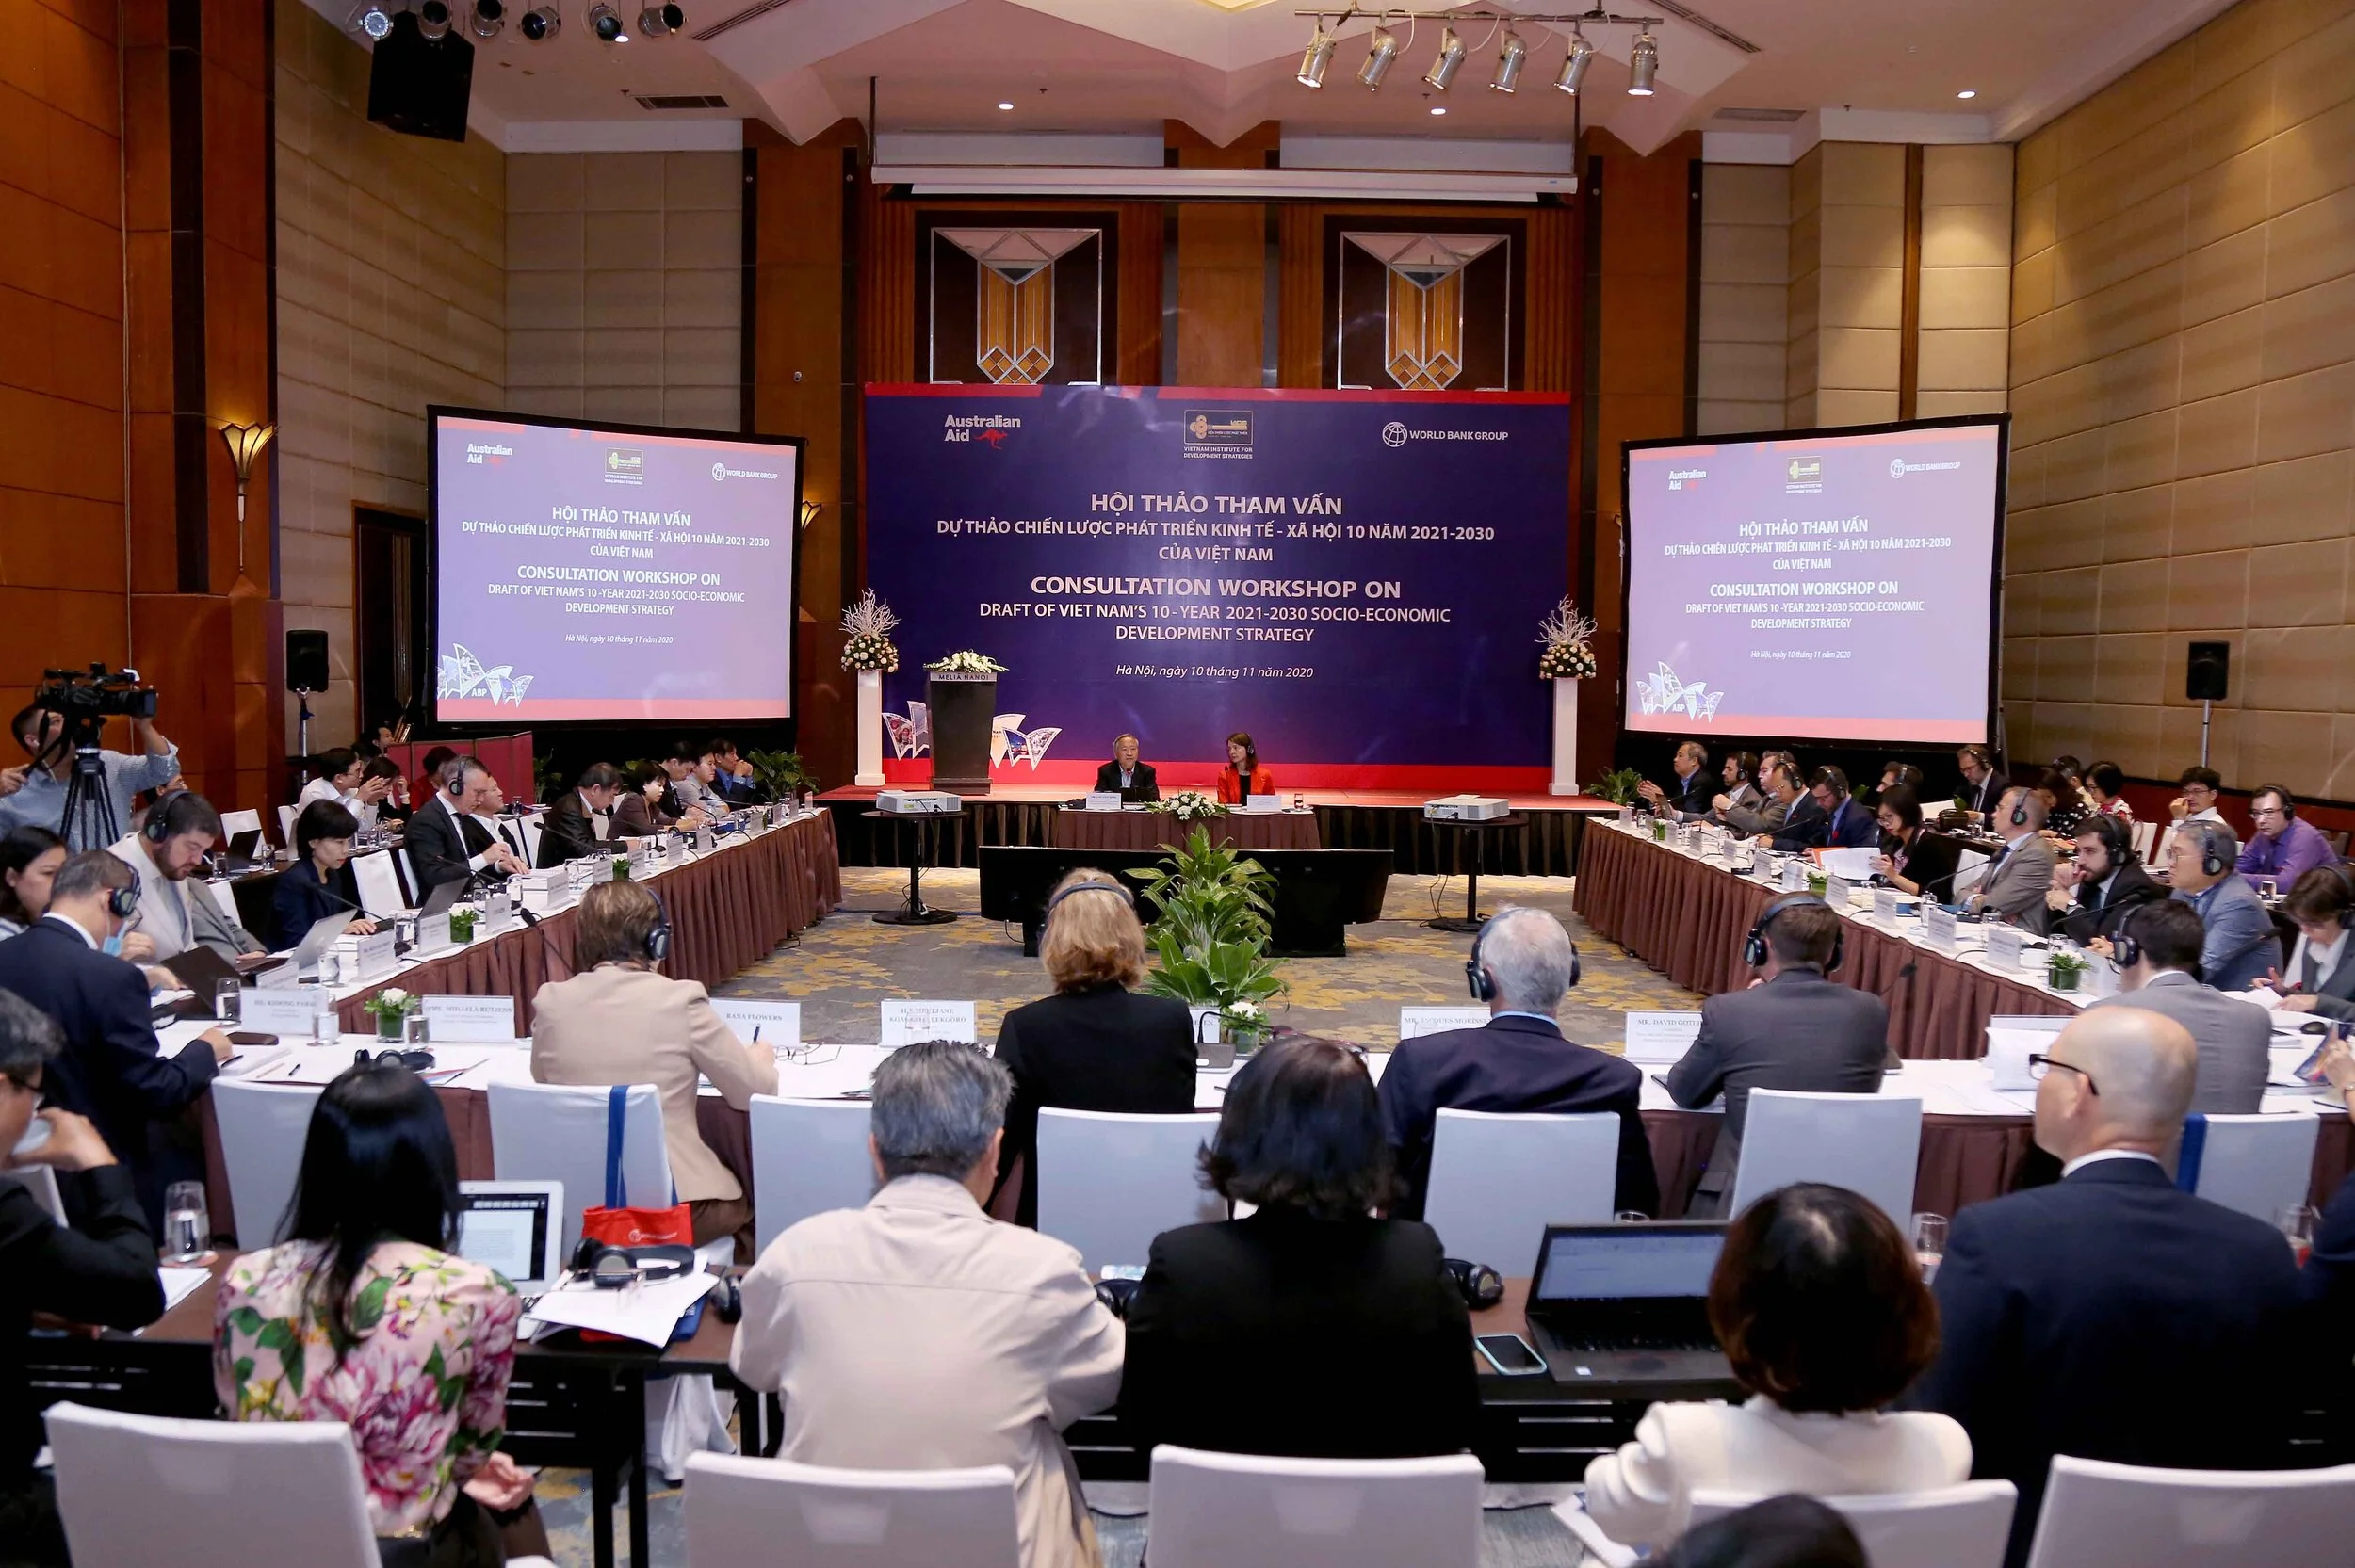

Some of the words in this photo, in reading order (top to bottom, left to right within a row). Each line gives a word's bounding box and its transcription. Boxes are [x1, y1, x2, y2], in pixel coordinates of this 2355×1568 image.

[945, 415, 1021, 428] Australian
[944, 429, 970, 442] Aid
[1410, 430, 1445, 439] WORLD
[1448, 431, 1473, 440] BANK
[1475, 432, 1508, 441] GROUP
[467, 444, 513, 456] Australian
[467, 454, 482, 464] Aid
[1092, 492, 1133, 516] HỘI
[1141, 491, 1208, 513] THẢO
[1215, 496, 1286, 514] THAM
[1292, 493, 1341, 514] VẤN
[552, 505, 577, 524] HỘI
[581, 506, 618, 523] THẢO
[622, 510, 659, 525] THAM
[664, 510, 690, 526] VẤN
[462, 521, 478, 535] DỰ
[479, 521, 506, 533] THẢO
[509, 522, 536, 536] CHIẾN
[539, 525, 565, 539] LƯỢC
[566, 526, 590, 538] PHÁT
[592, 526, 617, 540] TRIỂN
[620, 529, 642, 541] KINH
[643, 529, 654, 542] TẾ
[660, 531, 672, 542] XÃ
[674, 532, 690, 545] HỘI
[692, 535, 702, 543] 10
[705, 533, 724, 544] NĂM
[726, 536, 770, 547] 2021-2030
[937, 519, 963, 537] DỰ
[965, 516, 1010, 534] THẢO
[1015, 516, 1063, 534] CHIẾN
[1068, 520, 1112, 538] LƯỢC
[1115, 520, 1158, 536] PHÁT
[1161, 519, 1208, 536] TRIỂN
[1211, 524, 1251, 537] KINH
[1255, 520, 1274, 538] TẾ
[1287, 522, 1307, 538] XÃ
[1313, 523, 1341, 542] HỘI
[1347, 525, 1365, 539] 10
[1370, 523, 1407, 539] NĂM
[1411, 526, 1495, 541] 2021-2030
[1740, 521, 1762, 540] HỘI
[1764, 518, 1798, 536] THẢO
[1802, 521, 1838, 534] THAM
[1843, 515, 1868, 533] VẤN
[590, 543, 609, 556] CỦA
[610, 545, 630, 559] VIỆT
[632, 547, 653, 558] NAM
[1159, 543, 1192, 560] CỦA
[1195, 545, 1230, 564] VIỆT
[1235, 548, 1274, 561] NAM
[1773, 558, 1790, 570] CỦA
[1792, 558, 1810, 572] VIỆT
[1811, 558, 1831, 569] NAM
[517, 565, 618, 582] CONSULTATION
[623, 570, 697, 585] WORKSHOP
[701, 574, 720, 586] ON
[488, 584, 519, 595] DRAFT
[520, 585, 533, 595] OF
[535, 586, 554, 596] VIET
[587, 588, 596, 597] 10
[625, 590, 669, 600] 2021-2030
[672, 590, 745, 602] SOCIO-ECONOMIC
[1031, 576, 1210, 596] CONSULTATION
[1218, 579, 1357, 598] WORKSHOP
[1365, 582, 1401, 598] ON
[1710, 583, 1799, 597] CONSULTATION
[1803, 581, 1875, 595] WORKSHOP
[1878, 581, 1898, 594] ON
[565, 603, 630, 614] DEVELOPMENT
[632, 605, 674, 615] STRATEGY
[980, 603, 1031, 617] DRAFT
[1035, 604, 1055, 618] OF
[1059, 604, 1093, 618] VIET
[1226, 606, 1307, 621] 2021-2030
[1311, 607, 1451, 622] SOCIO-ECONOMIC
[1686, 603, 1711, 613] DRAFT
[1713, 604, 1723, 613] OF
[1725, 603, 1741, 613] VIET
[1771, 604, 1779, 612] 10
[1807, 603, 1847, 612] 2021-2030
[1849, 601, 1925, 612] SOCIO-ECONOMIC
[1752, 618, 1810, 629] DEVELOPMENT
[1811, 618, 1852, 629] STRATEGY
[1116, 626, 1232, 640] DEVELOPMENT
[1236, 628, 1315, 641] STRATEGY
[1116, 665, 1131, 674] Hà
[1135, 665, 1156, 677] Nội,
[1159, 666, 1188, 678] ngày
[1191, 666, 1204, 675] 10
[1206, 666, 1240, 679] tháng
[1242, 667, 1255, 676] 11
[1258, 666, 1283, 677] năm
[1285, 668, 1314, 678] 2020
[472, 688, 487, 697] ABP
